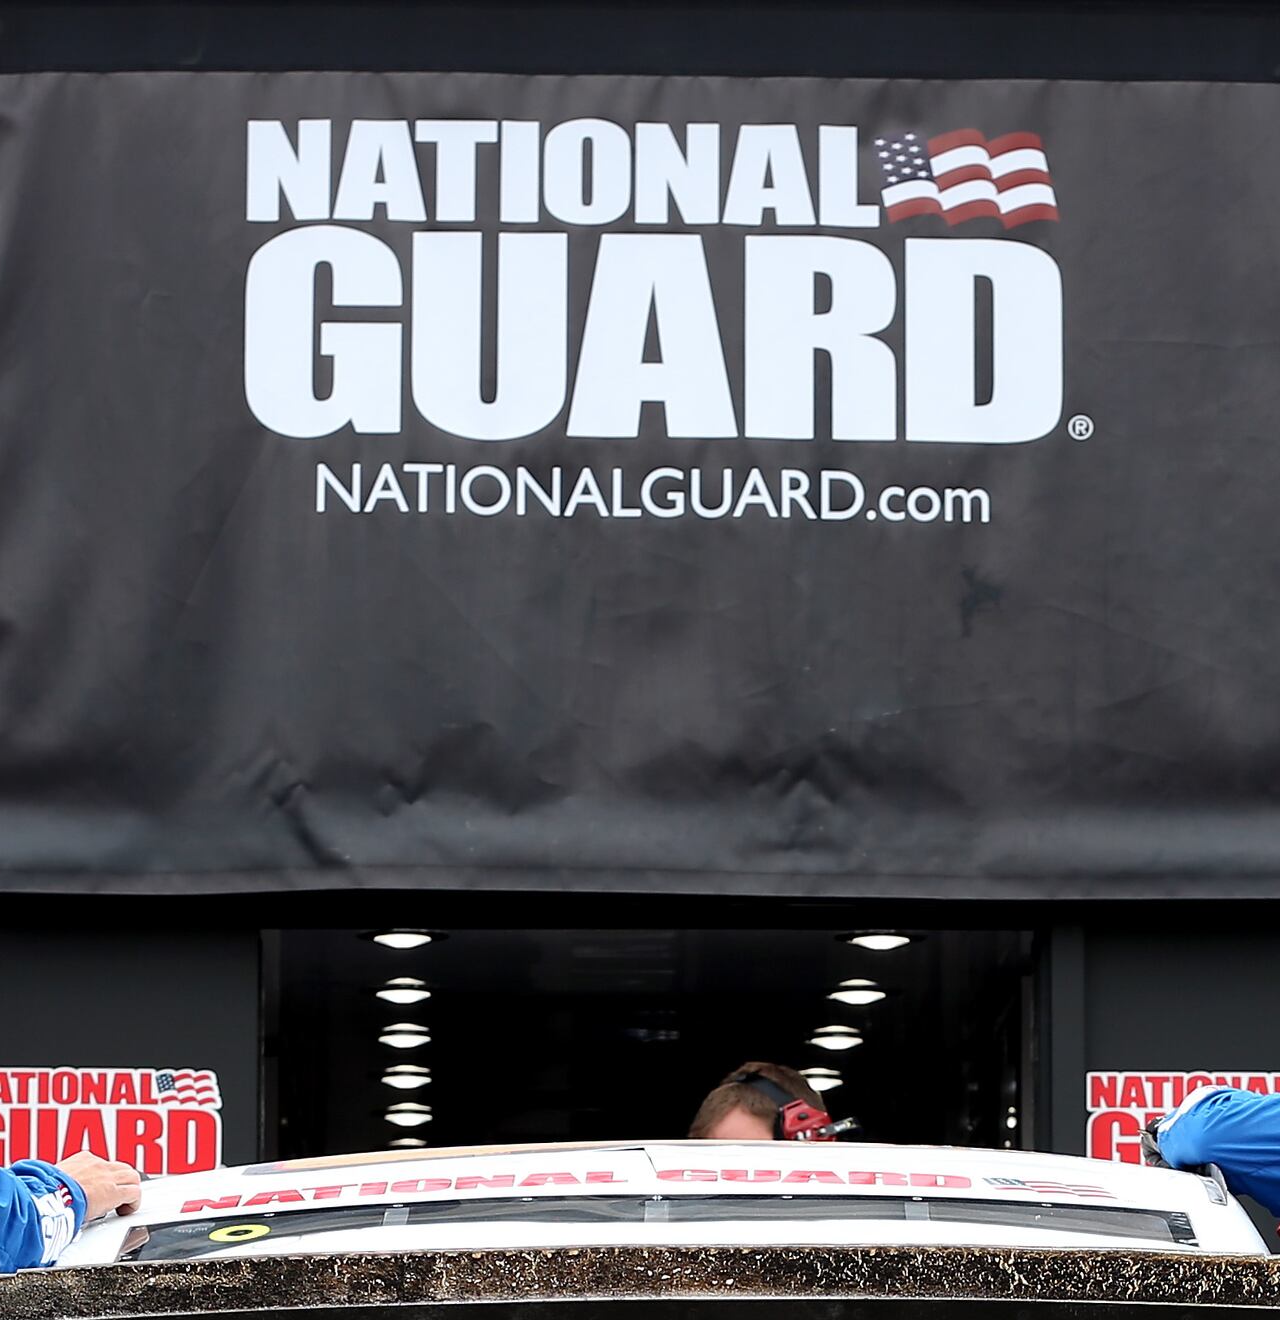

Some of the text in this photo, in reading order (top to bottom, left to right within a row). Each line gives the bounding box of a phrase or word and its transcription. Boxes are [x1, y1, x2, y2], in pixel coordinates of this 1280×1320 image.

[245, 118, 880, 228] NATIONAL
[244, 224, 1064, 444] GUARD
[316, 462, 990, 523] NATIONALGUARD.com
[180, 1169, 972, 1213] NATIONAL GUARD
